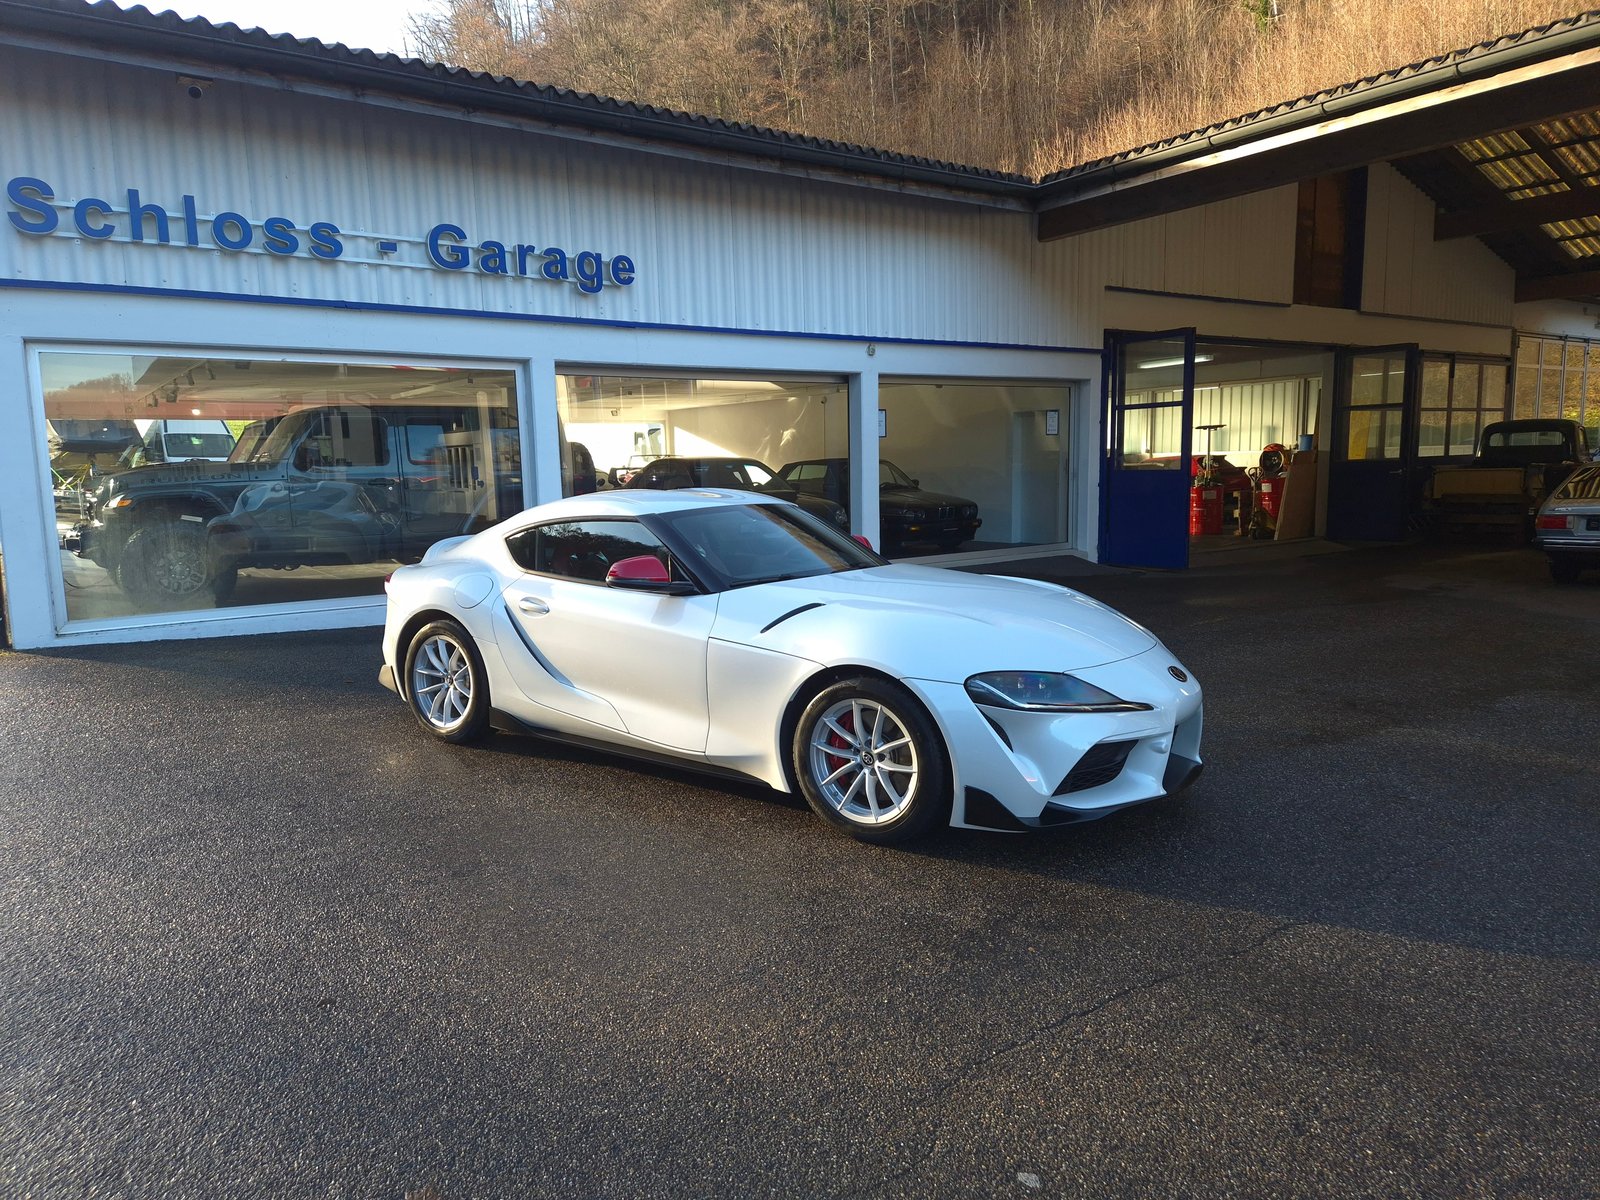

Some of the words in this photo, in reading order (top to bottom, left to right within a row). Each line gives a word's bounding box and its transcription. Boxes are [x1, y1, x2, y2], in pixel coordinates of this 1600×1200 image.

[7, 176, 344, 258] Schloss
[378, 241, 397, 252] -
[427, 223, 636, 294] Garage
